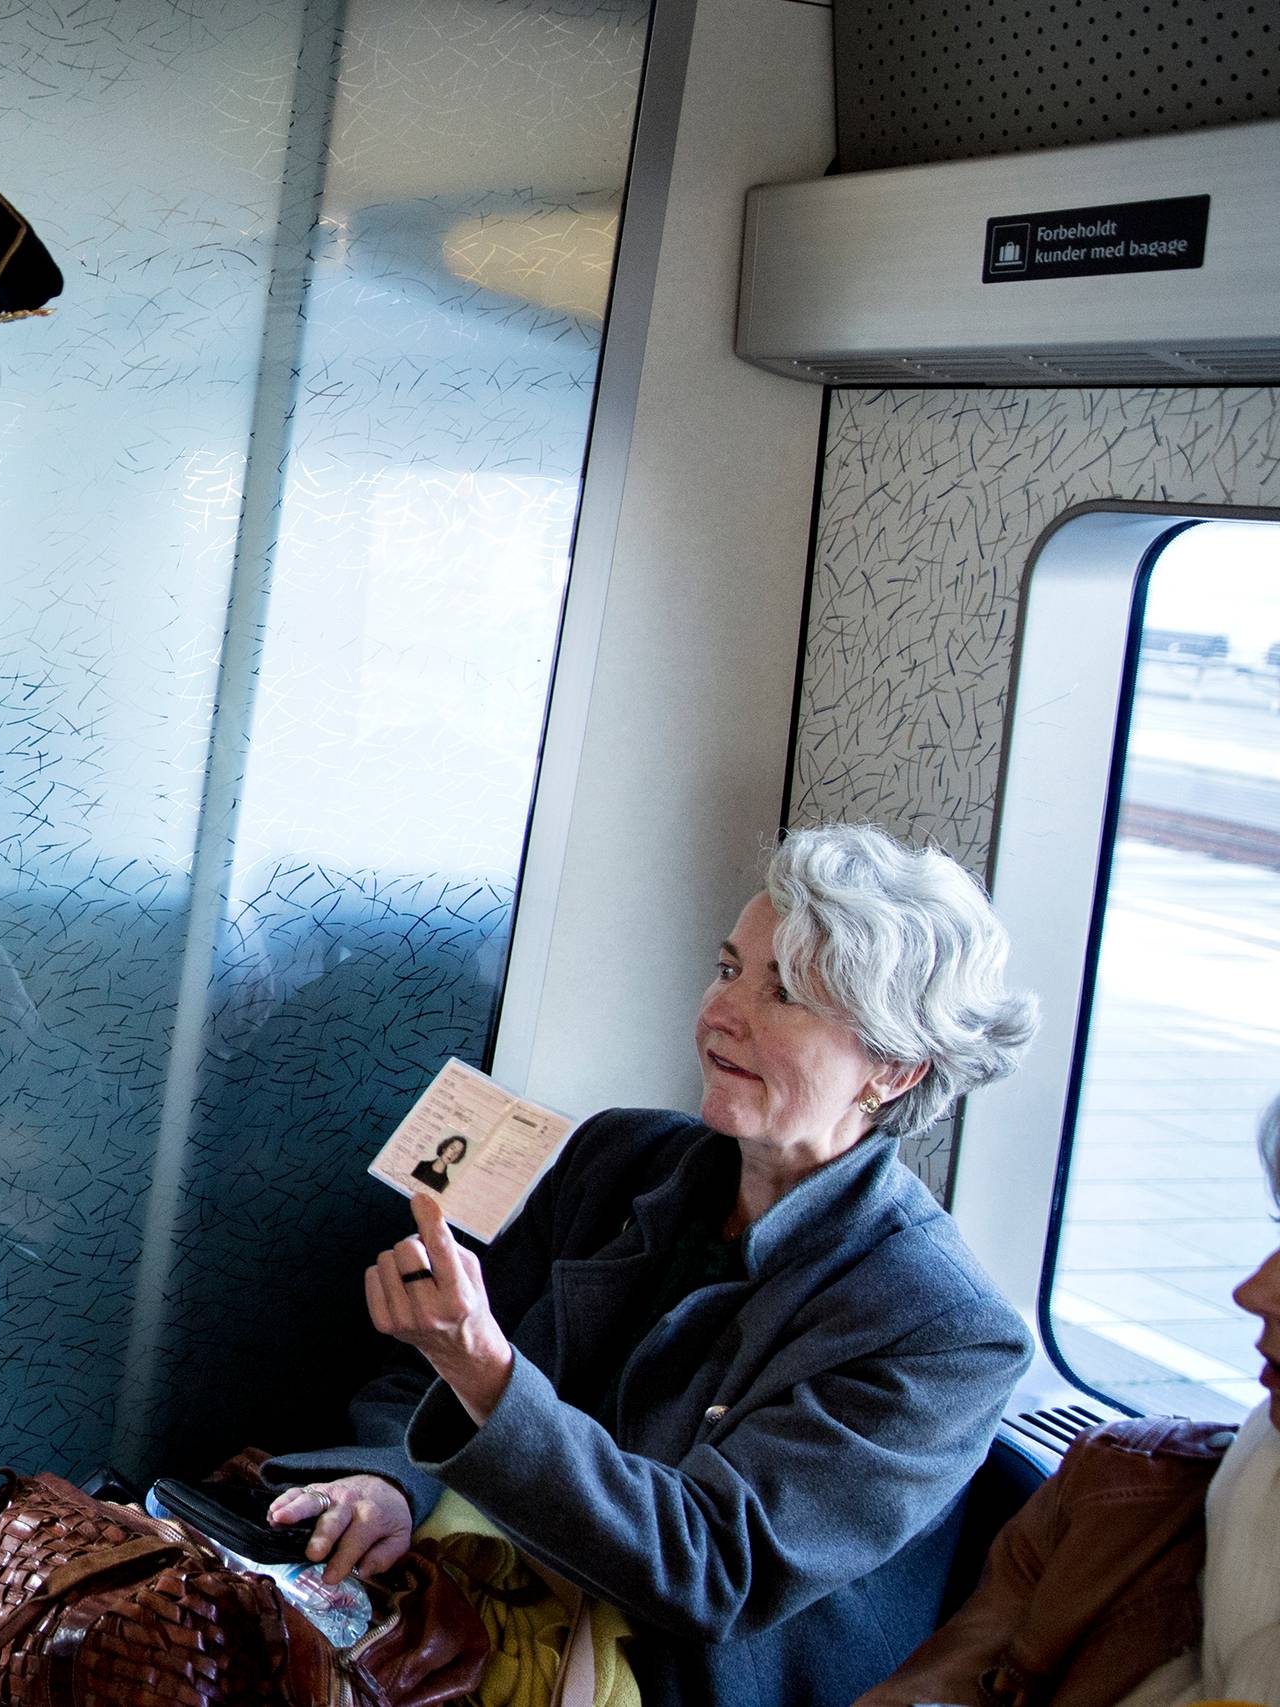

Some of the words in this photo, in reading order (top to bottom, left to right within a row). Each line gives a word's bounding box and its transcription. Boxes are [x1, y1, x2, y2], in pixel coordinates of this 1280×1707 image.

[1037, 220, 1117, 241] Forbeholdt
[1035, 247, 1086, 264] kunder
[1091, 240, 1124, 258] med
[1130, 238, 1188, 256] bagage
